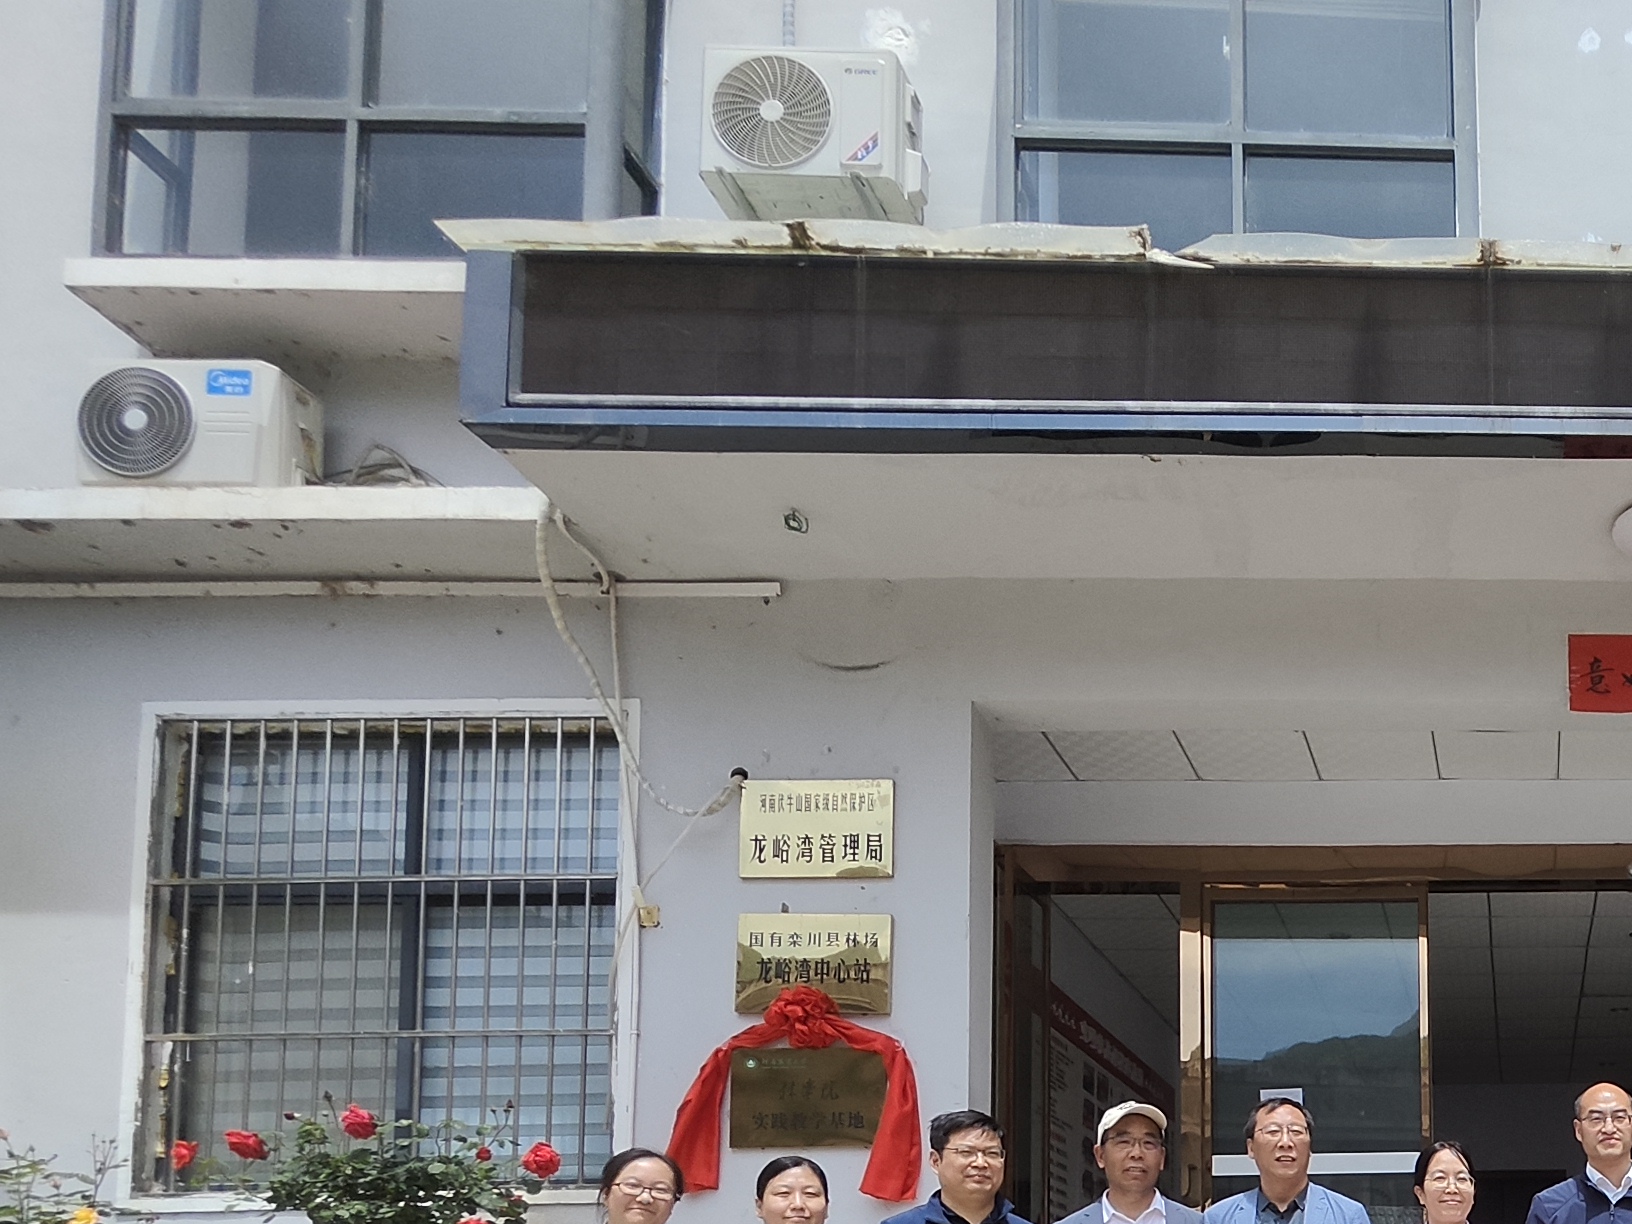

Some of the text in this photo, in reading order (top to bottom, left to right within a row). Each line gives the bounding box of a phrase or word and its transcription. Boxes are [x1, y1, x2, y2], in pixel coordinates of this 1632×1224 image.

[759, 793, 876, 813] 河南伏牛山国家级自然保护区
[749, 833, 884, 864] 龙峪湾管理局
[749, 932, 879, 948] 国有栾川县林场
[756, 957, 872, 984] 龙峪湾中心站
